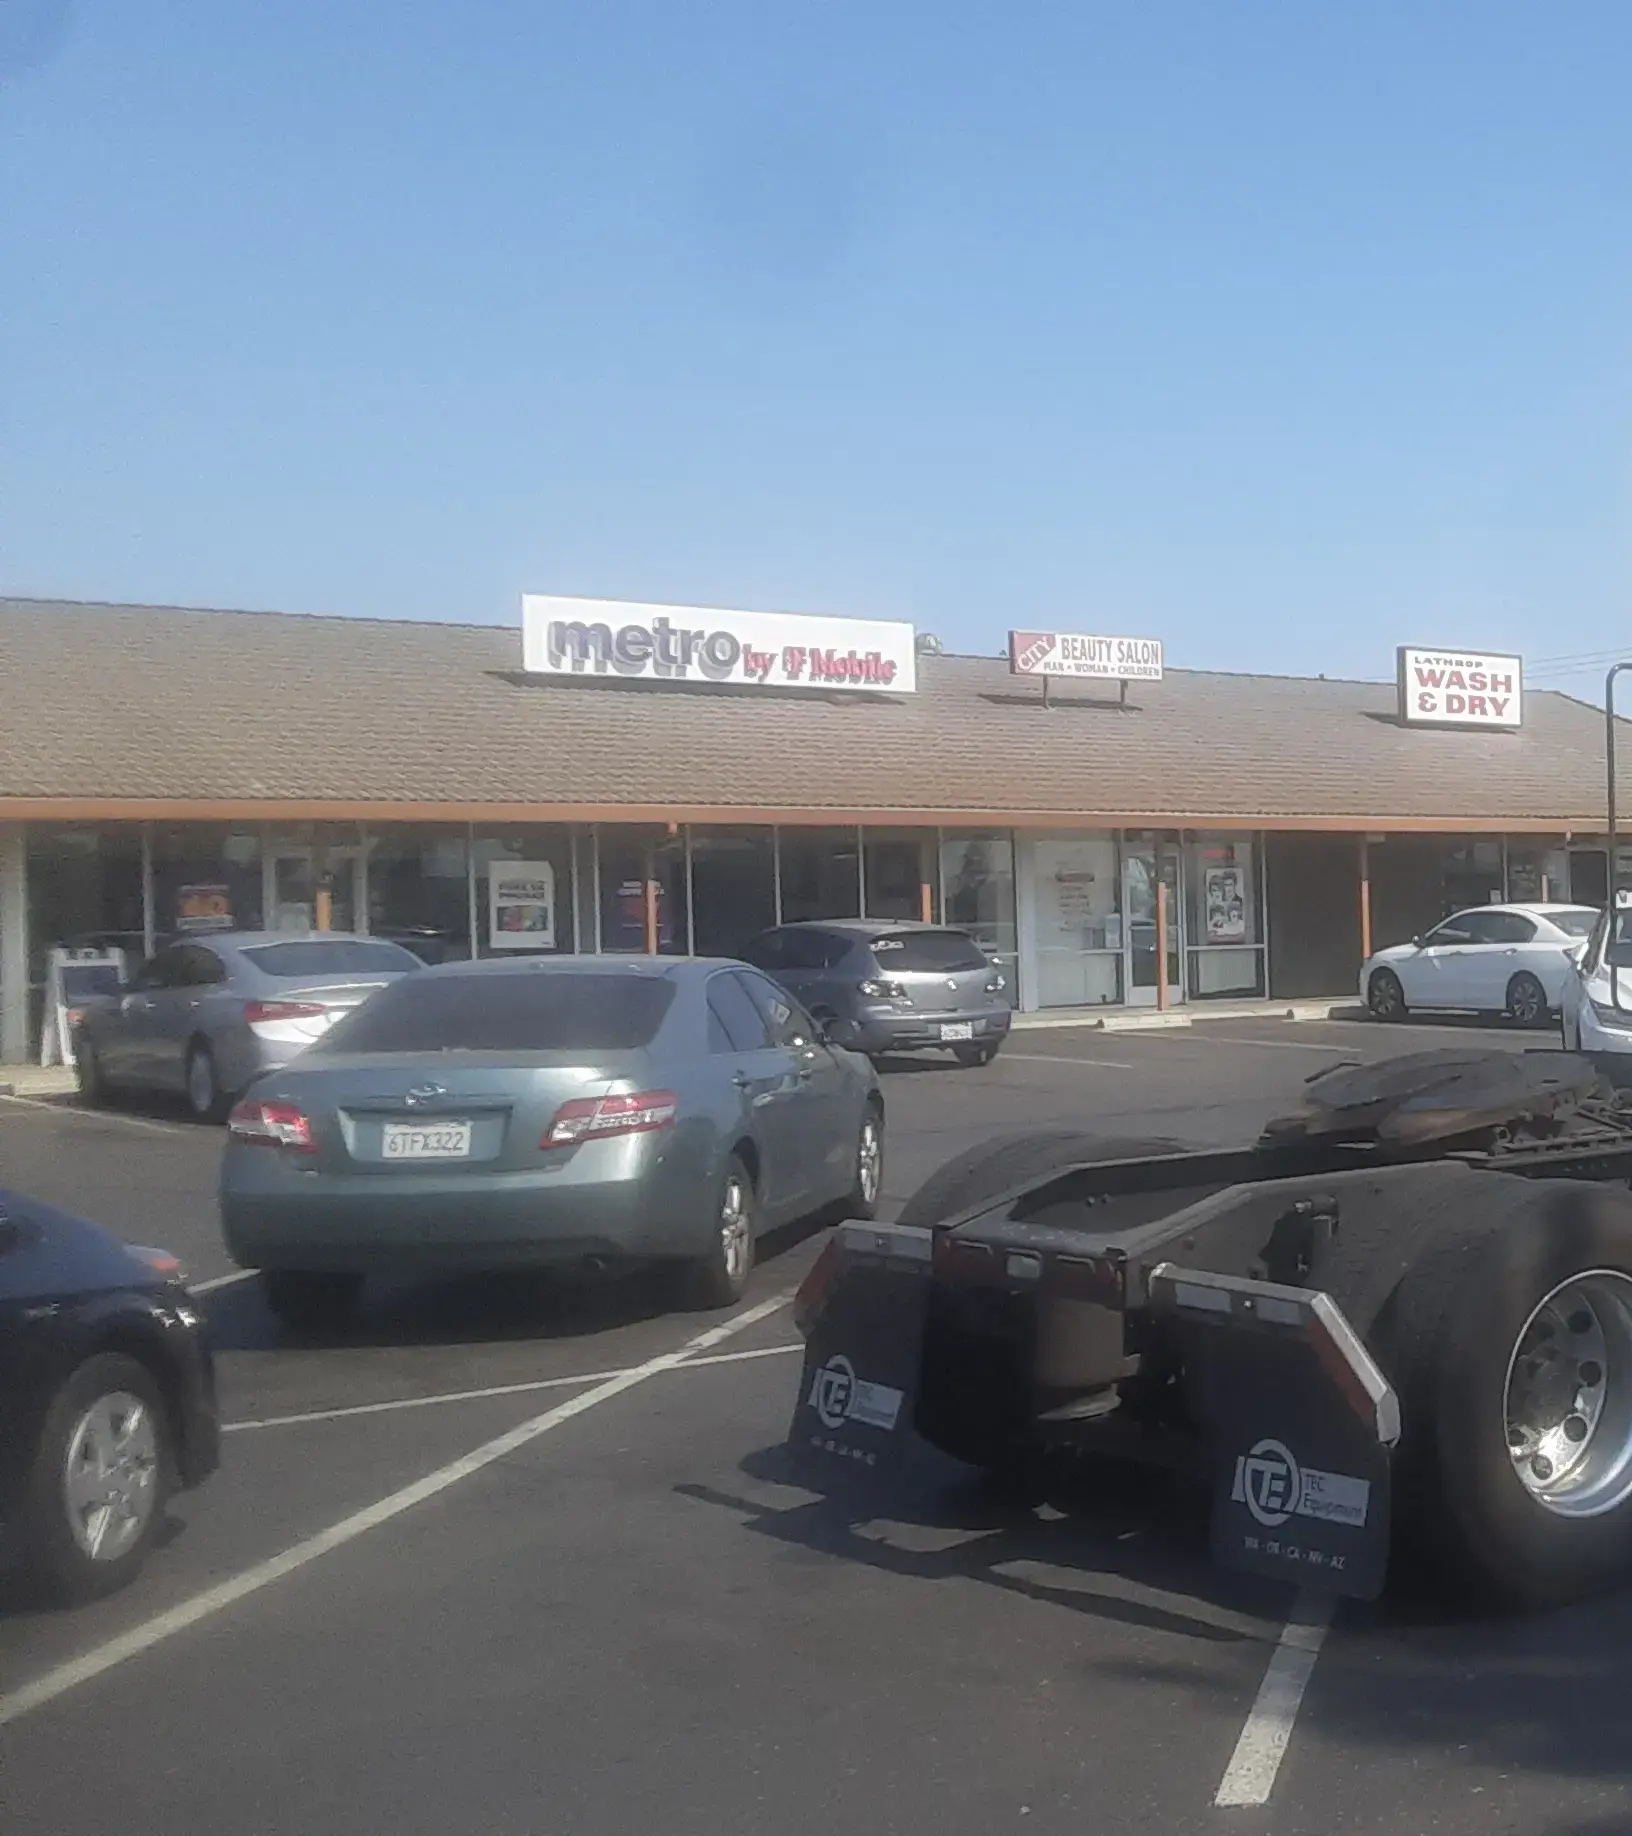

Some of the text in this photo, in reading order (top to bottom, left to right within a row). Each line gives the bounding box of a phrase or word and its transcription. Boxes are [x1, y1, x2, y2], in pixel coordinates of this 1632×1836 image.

[549, 617, 741, 680] metro
[742, 644, 779, 683] by
[1016, 635, 1051, 670] CITY
[1060, 637, 1160, 665] BEAUTY SALON
[1414, 656, 1484, 669] LATHROP
[1043, 661, 1160, 677] MAN WOMAN CHILDREN
[1414, 667, 1513, 694] WASH
[1418, 692, 1511, 717] & DRY
[1303, 1474, 1326, 1493] TEC
[1303, 1493, 1363, 1519] Equipment
